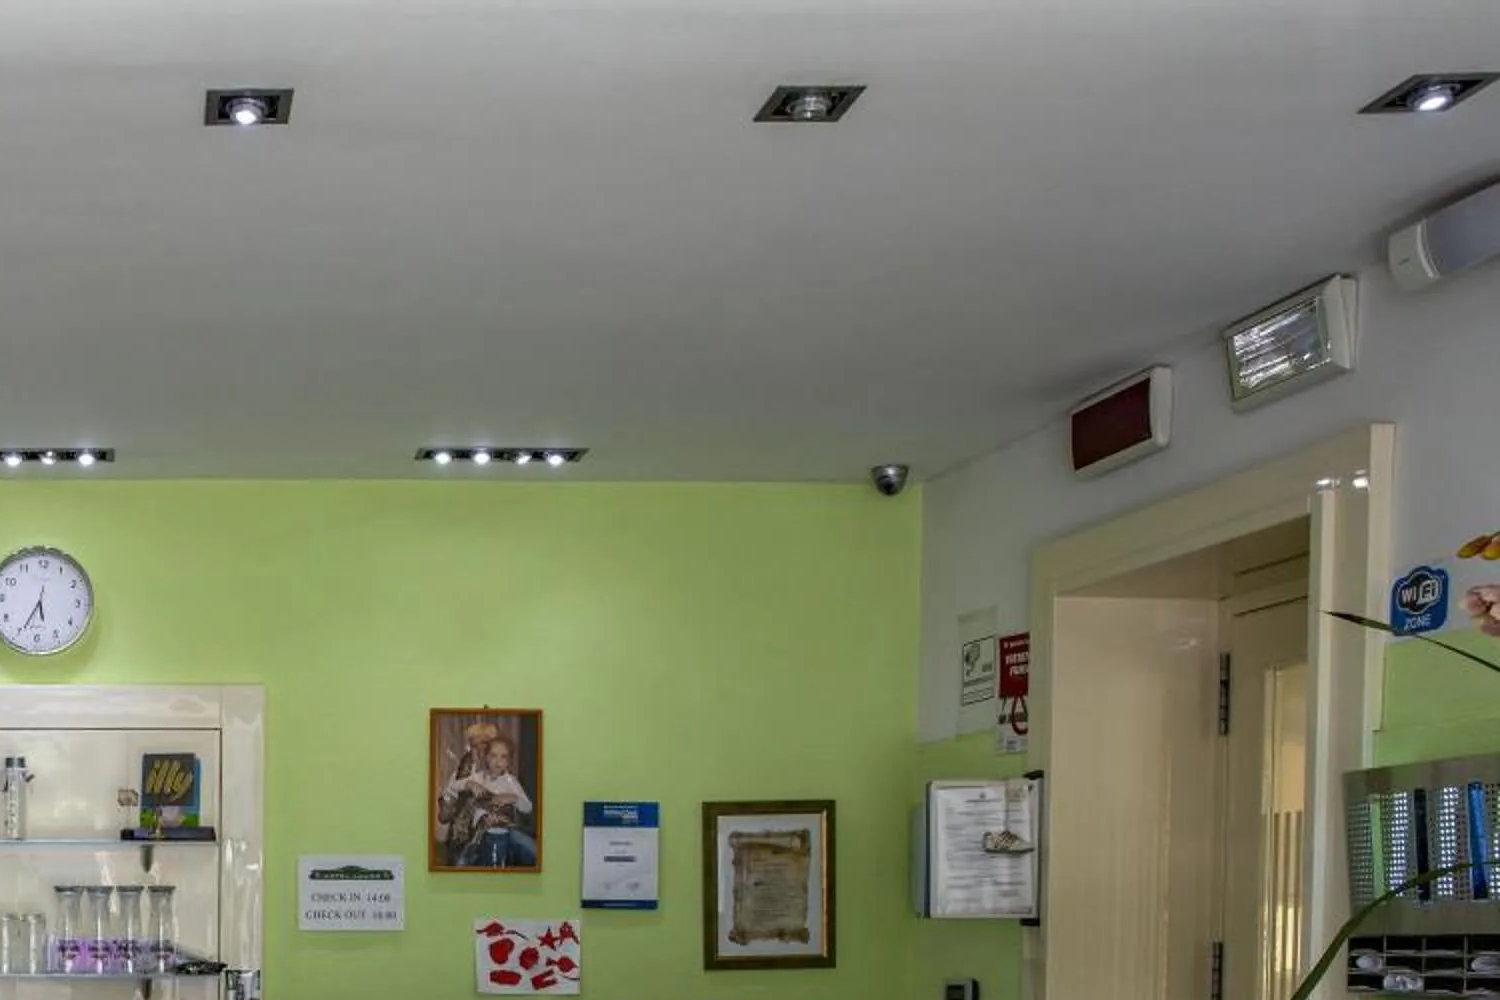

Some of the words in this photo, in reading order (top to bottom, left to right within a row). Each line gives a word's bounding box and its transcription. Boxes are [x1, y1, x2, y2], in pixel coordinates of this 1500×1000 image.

[5, 577, 17, 586] 10
[1404, 613, 1432, 631] ZONE
[311, 893, 347, 902] CHECK
[349, 893, 361, 902] IN
[305, 911, 341, 920] CHECK
[344, 911, 366, 920] OUT
